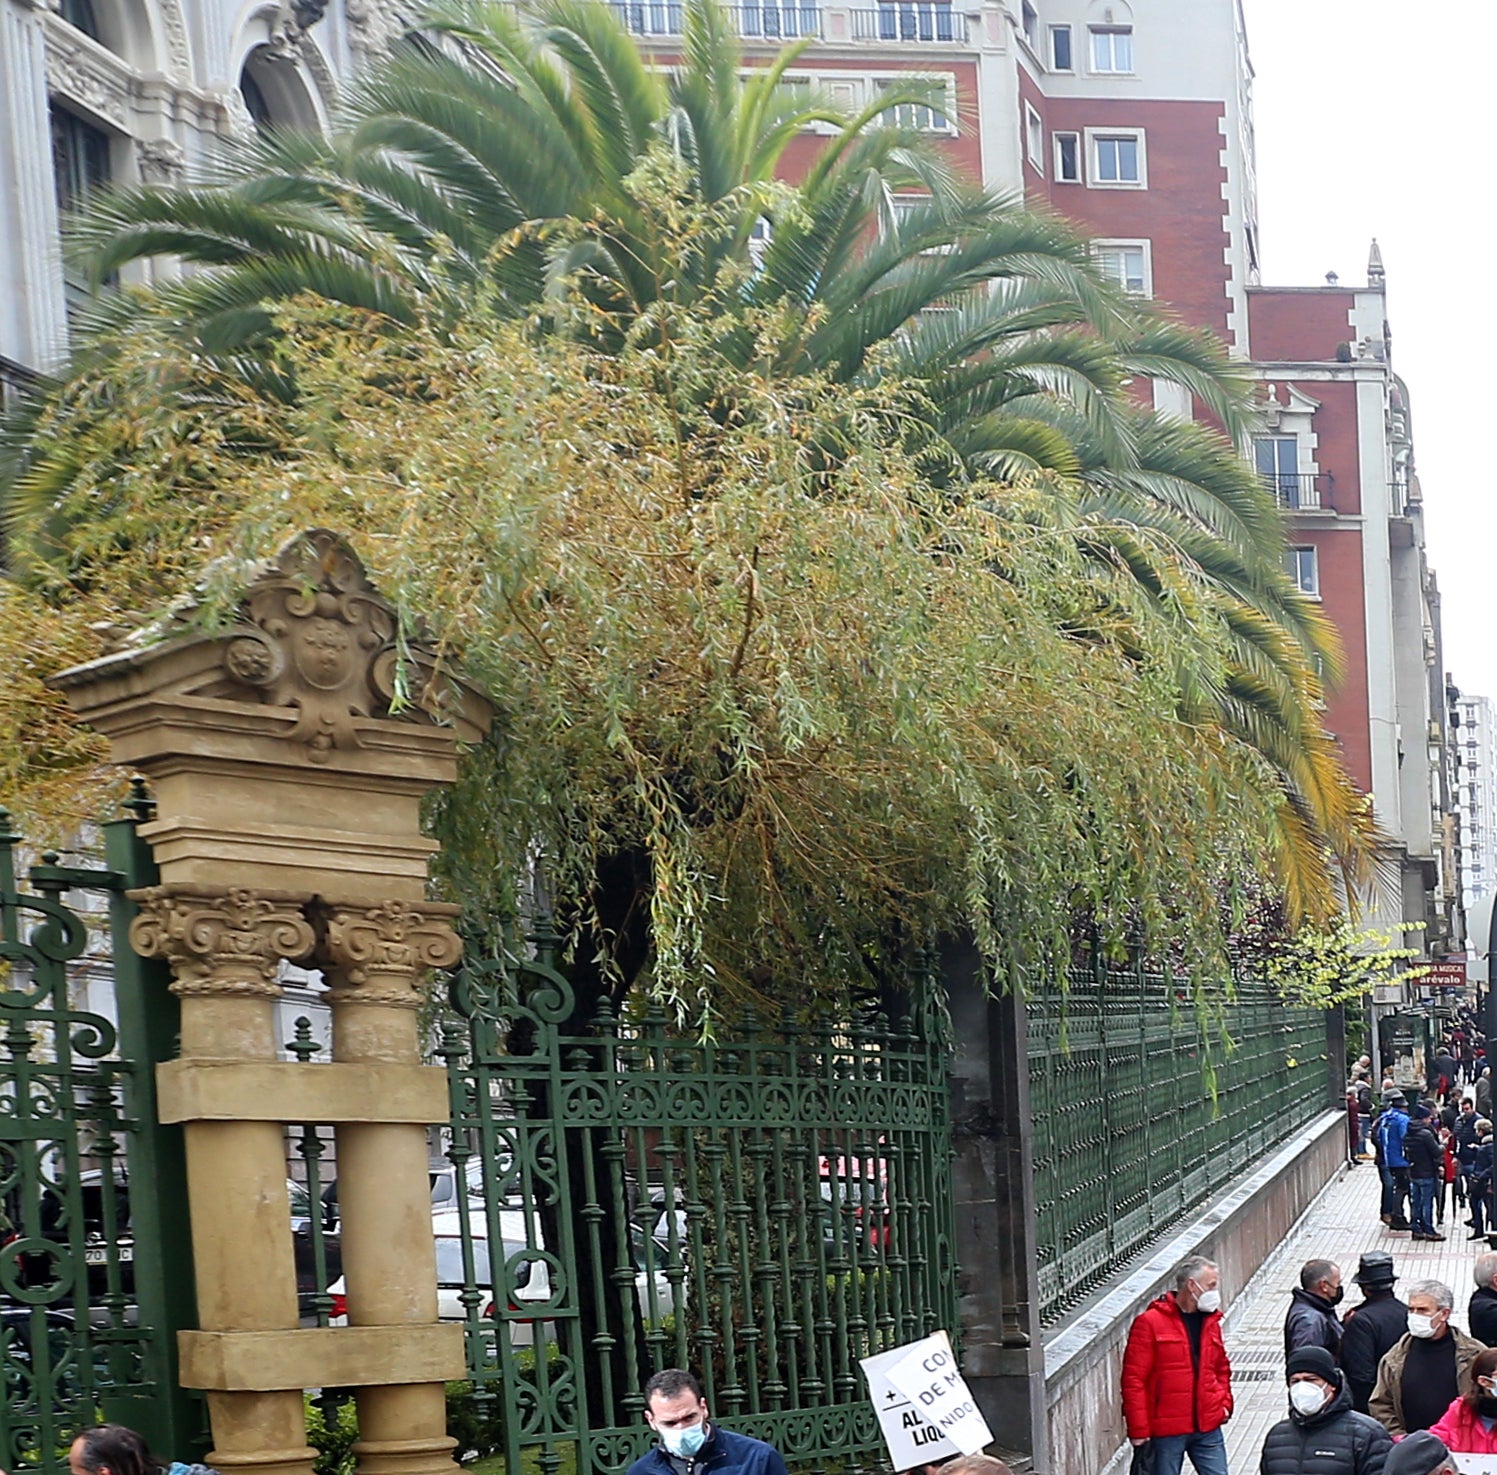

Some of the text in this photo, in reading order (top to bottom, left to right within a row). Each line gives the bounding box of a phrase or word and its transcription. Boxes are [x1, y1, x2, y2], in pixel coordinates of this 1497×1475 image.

[1420, 974, 1461, 984] arévalo
[919, 1381, 946, 1406] DE
[902, 1410, 923, 1429] AL
[912, 1424, 946, 1447] LIQU
